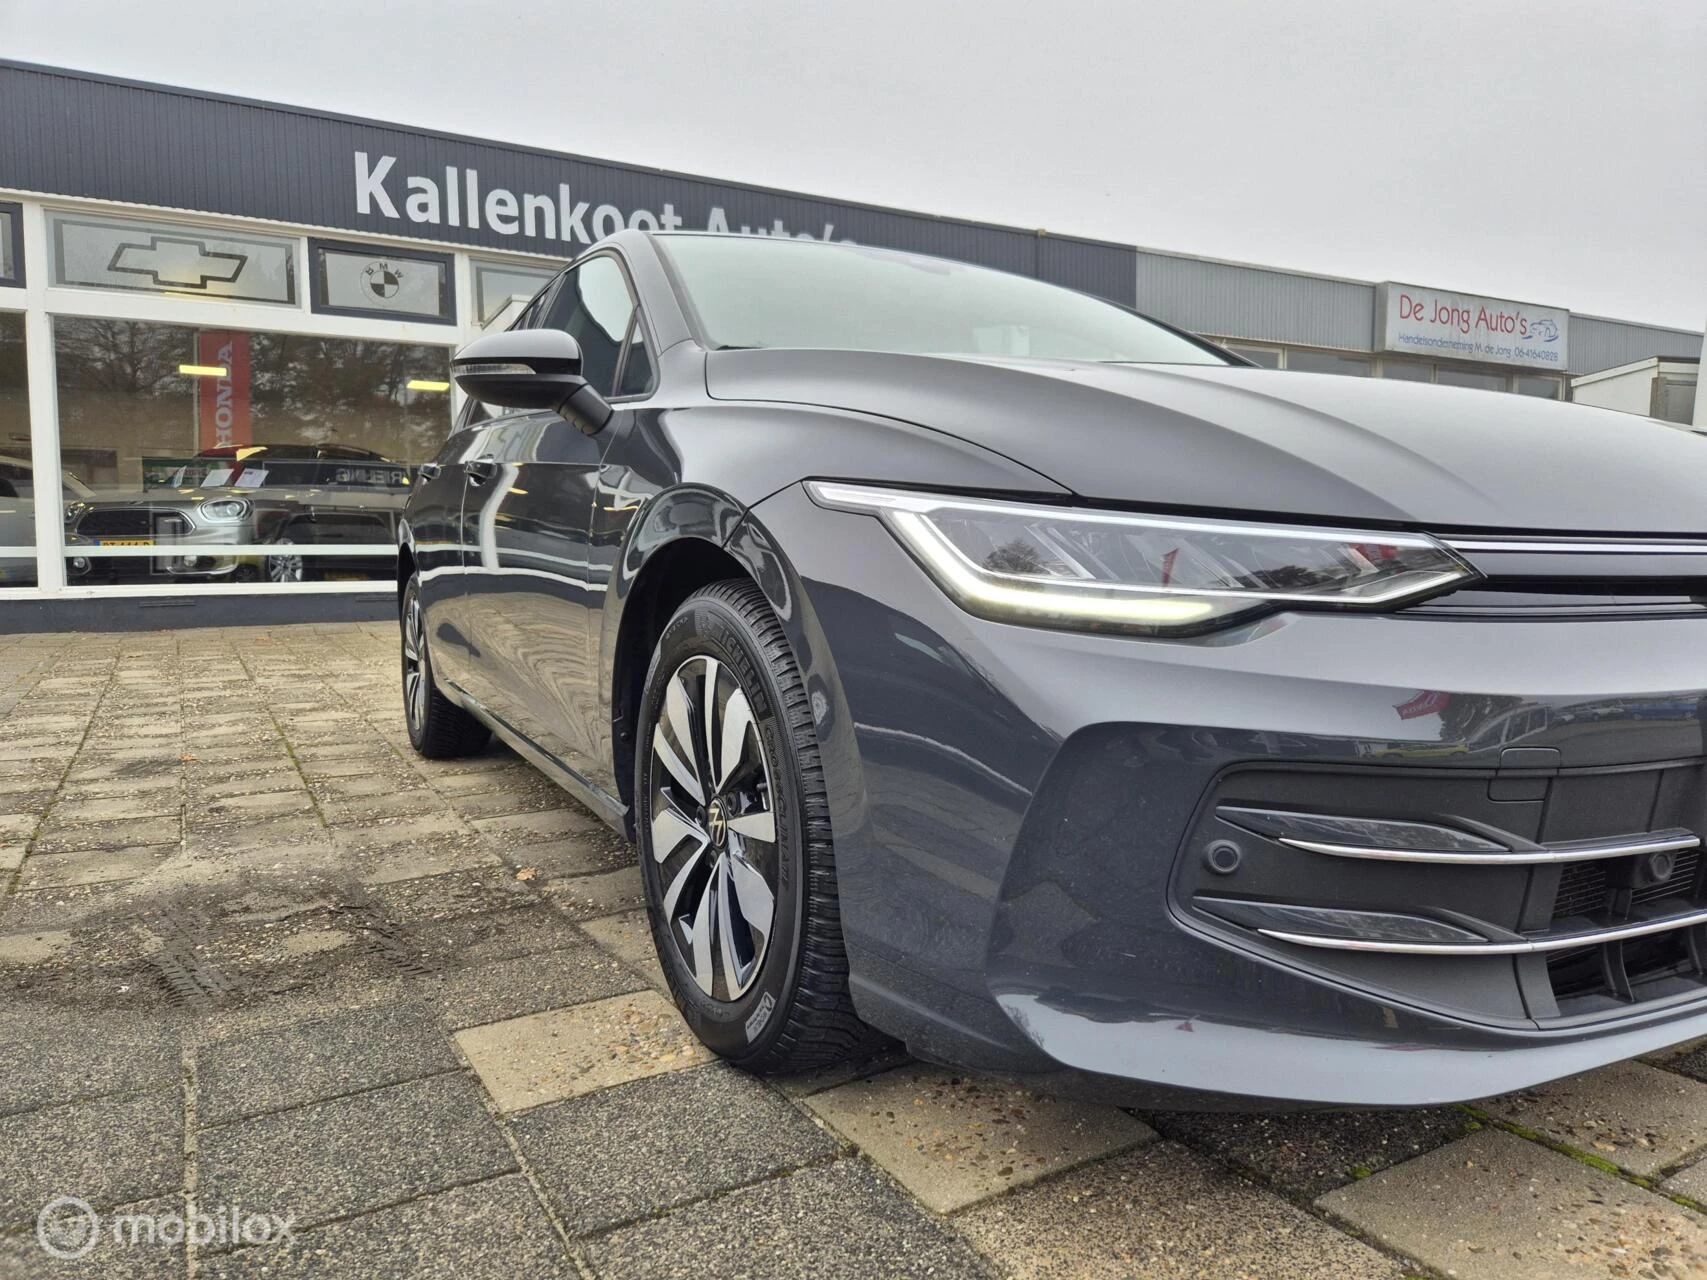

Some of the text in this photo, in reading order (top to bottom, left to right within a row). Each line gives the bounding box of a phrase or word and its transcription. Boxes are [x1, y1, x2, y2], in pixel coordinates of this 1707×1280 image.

[1399, 294, 1528, 336] De Jong Auto's
[215, 342, 233, 448] HONDA
